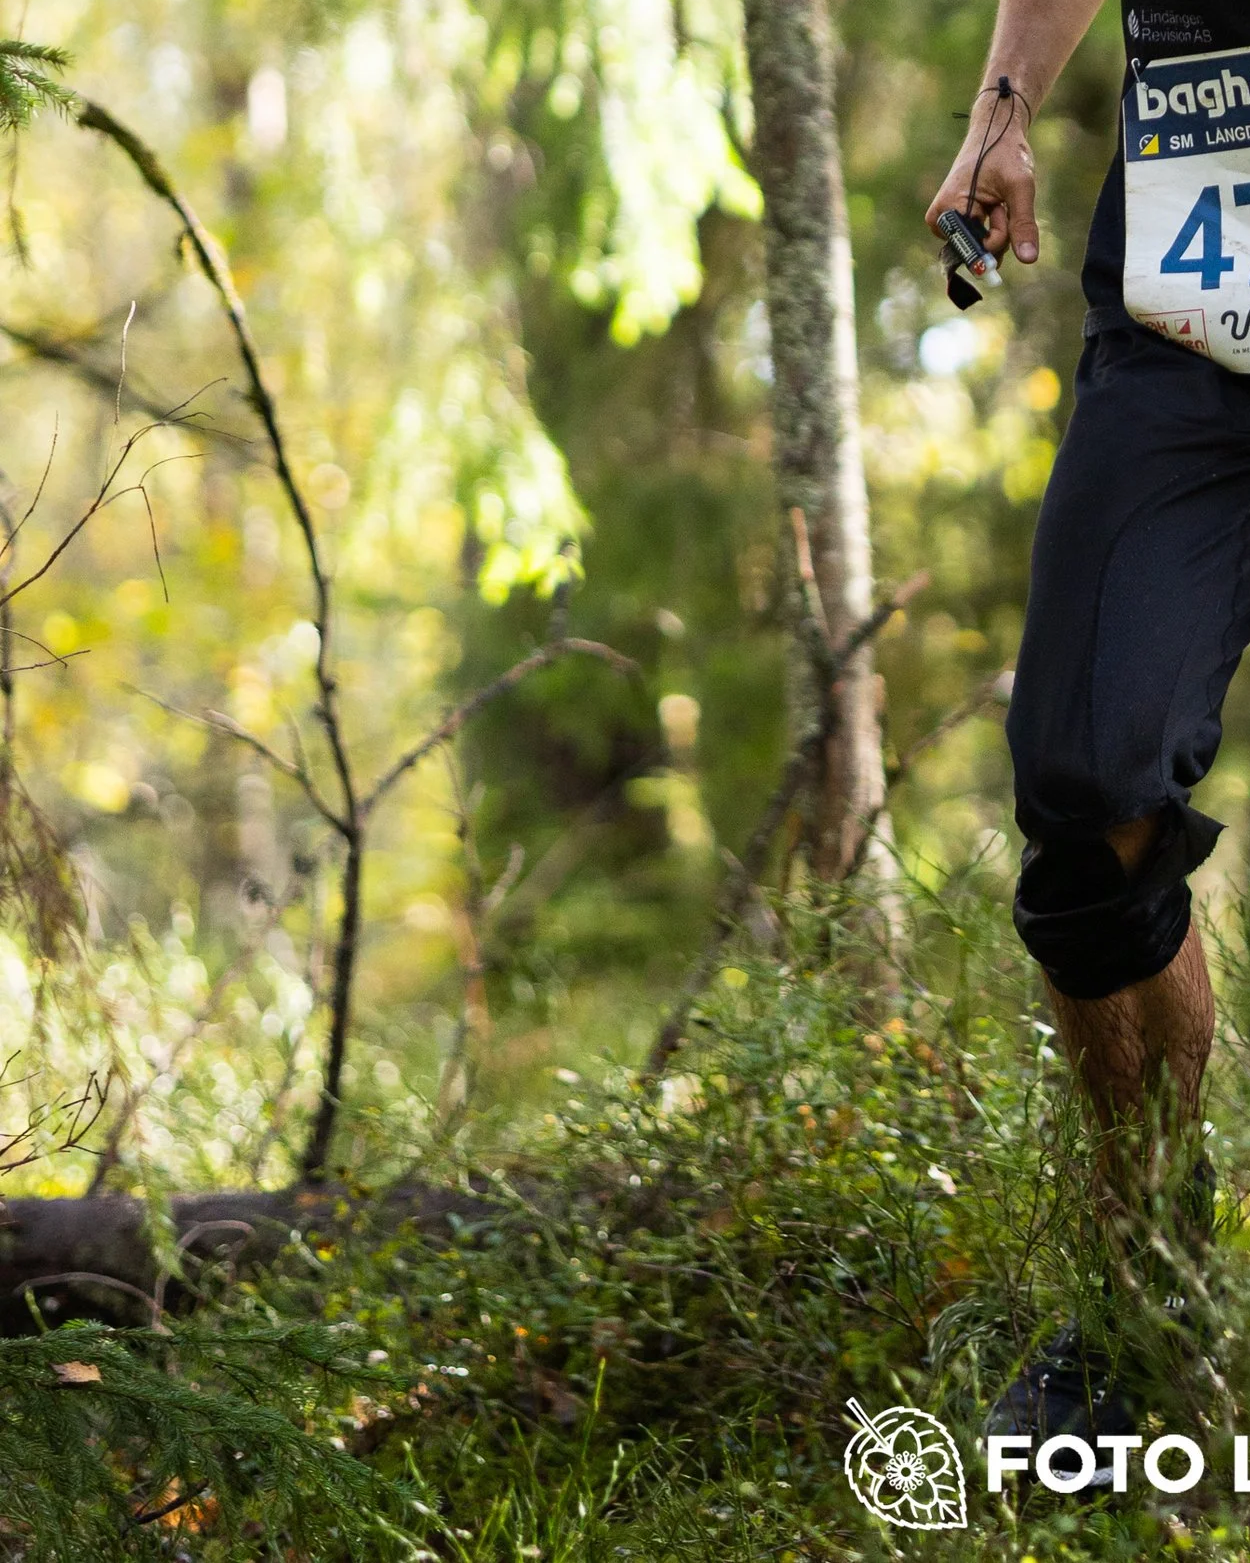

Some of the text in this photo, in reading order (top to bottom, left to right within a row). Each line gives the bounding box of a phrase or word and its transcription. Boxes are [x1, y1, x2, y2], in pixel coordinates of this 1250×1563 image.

[1141, 27, 1212, 44] Revision AB
[1169, 133, 1194, 150] SM
